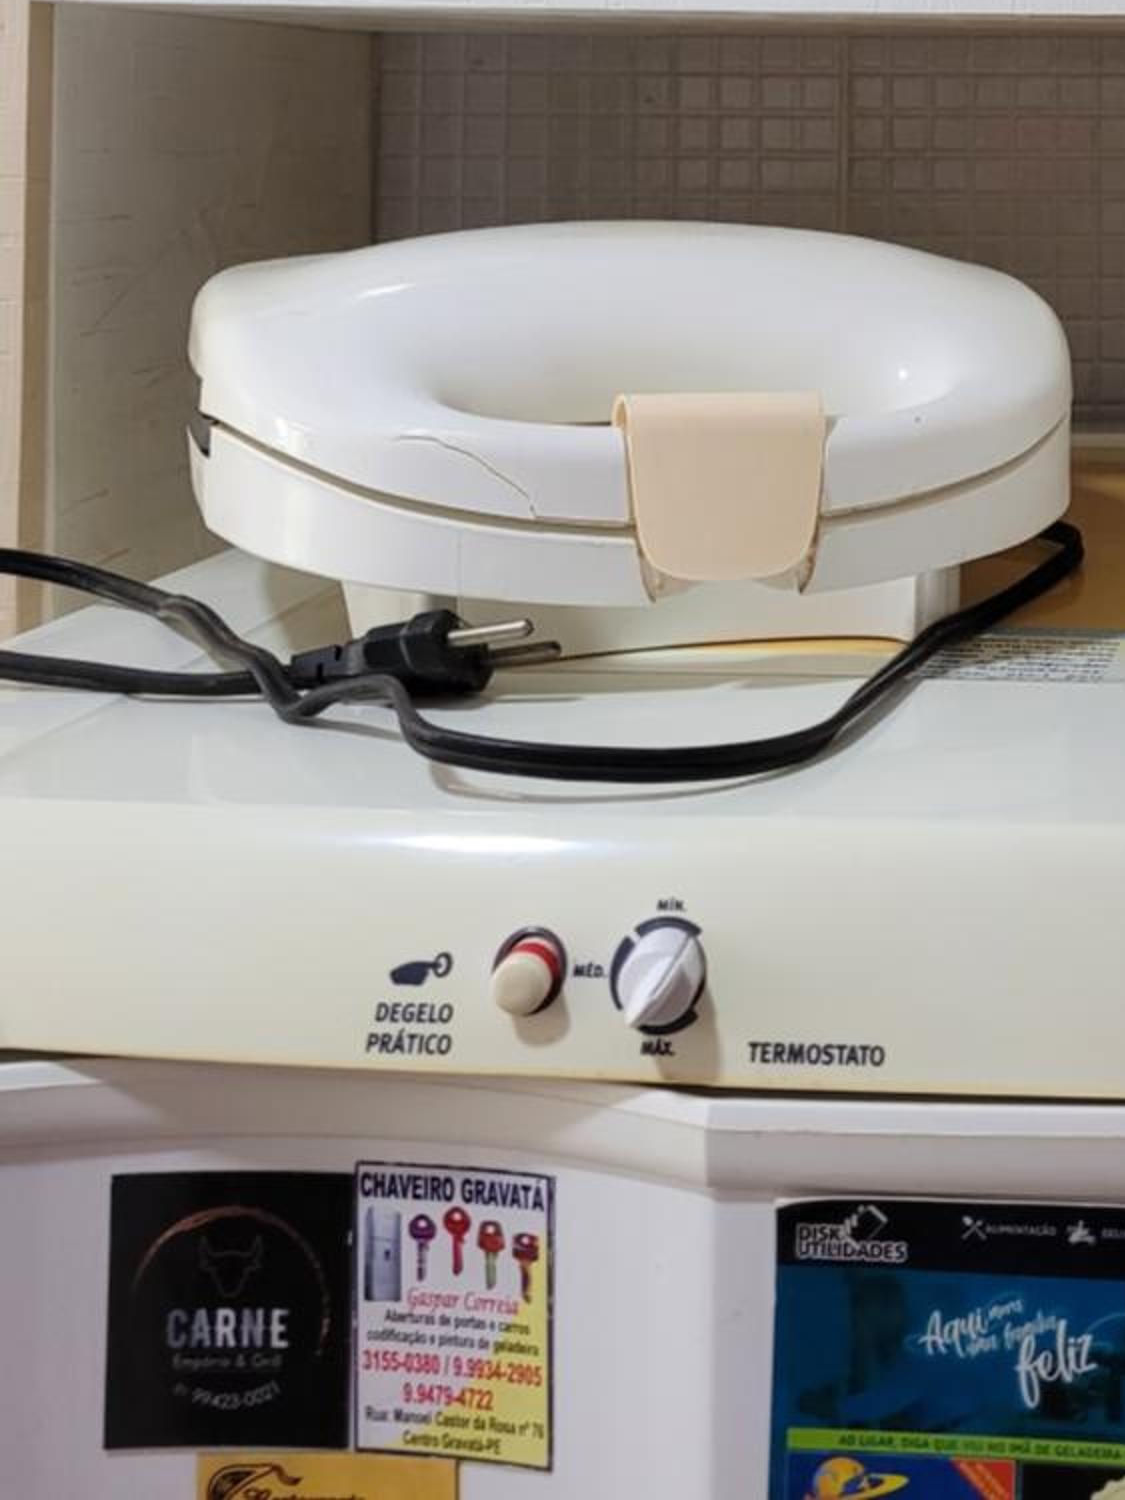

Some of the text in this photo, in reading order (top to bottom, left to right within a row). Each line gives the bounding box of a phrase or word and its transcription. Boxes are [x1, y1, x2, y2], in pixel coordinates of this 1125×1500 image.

[375, 1002, 454, 1023] DEGELO
[365, 1027, 452, 1055] PRÁTICO
[748, 1042, 885, 1067] TERMOSTATO
[360, 1172, 545, 1211] CHAVEIRO GRAVATÁ
[797, 1223, 845, 1241] DISK
[796, 1239, 907, 1263] UTILIDADES
[166, 1307, 289, 1349] CARNE
[438, 1314, 450, 1326] de
[1015, 1318, 1098, 1409] feliz
